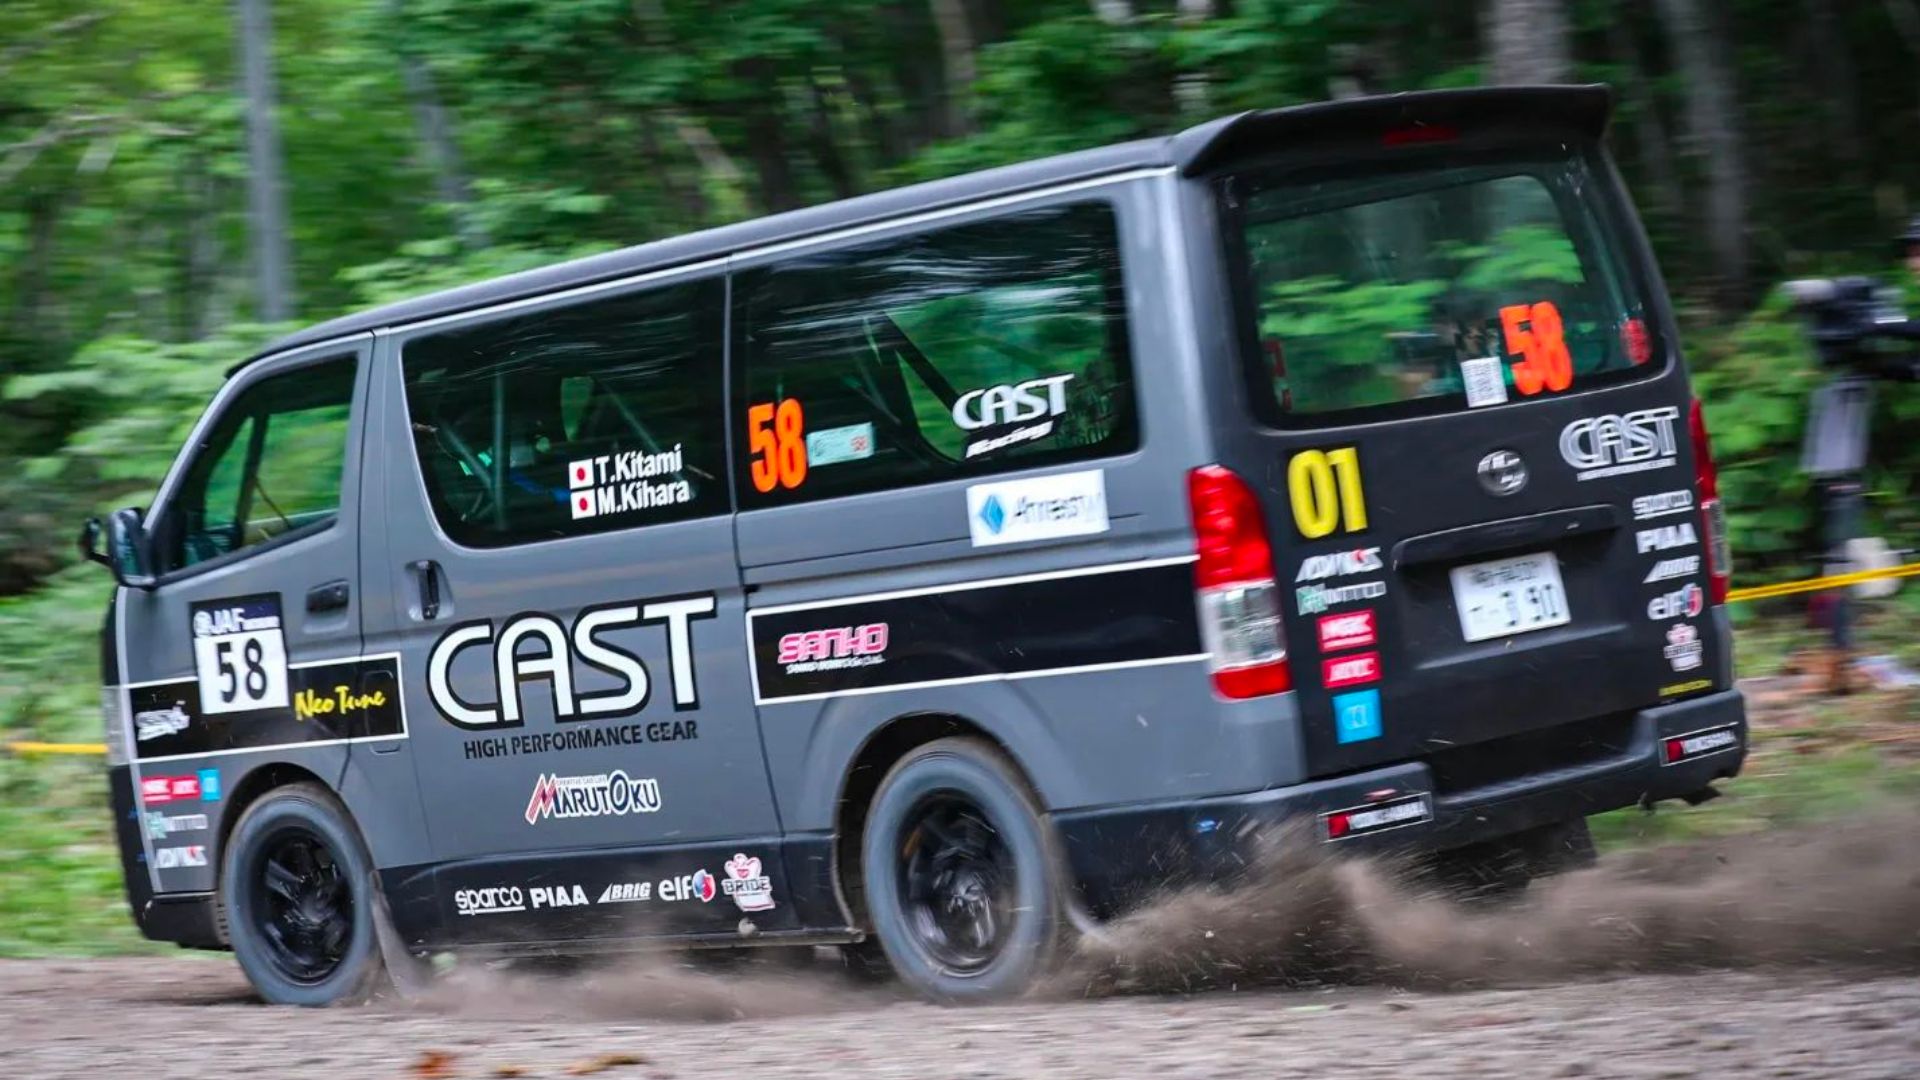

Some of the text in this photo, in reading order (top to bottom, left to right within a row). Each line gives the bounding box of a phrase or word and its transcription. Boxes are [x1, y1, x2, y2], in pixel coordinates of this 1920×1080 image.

[1499, 301, 1575, 396] 58
[952, 373, 1076, 431] CAST
[595, 443, 683, 485] T.Kitami
[748, 398, 807, 493] 58
[1559, 406, 1680, 470] CAST
[597, 480, 691, 516] M.Kihara
[1288, 447, 1369, 539] 01
[216, 637, 268, 704] 58
[425, 590, 718, 731] CAST
[295, 688, 335, 721] Neo
[464, 719, 699, 760] HIGH PERFORMANCE GEAR
[455, 886, 527, 916] sparco
[529, 884, 590, 909] PIAA
